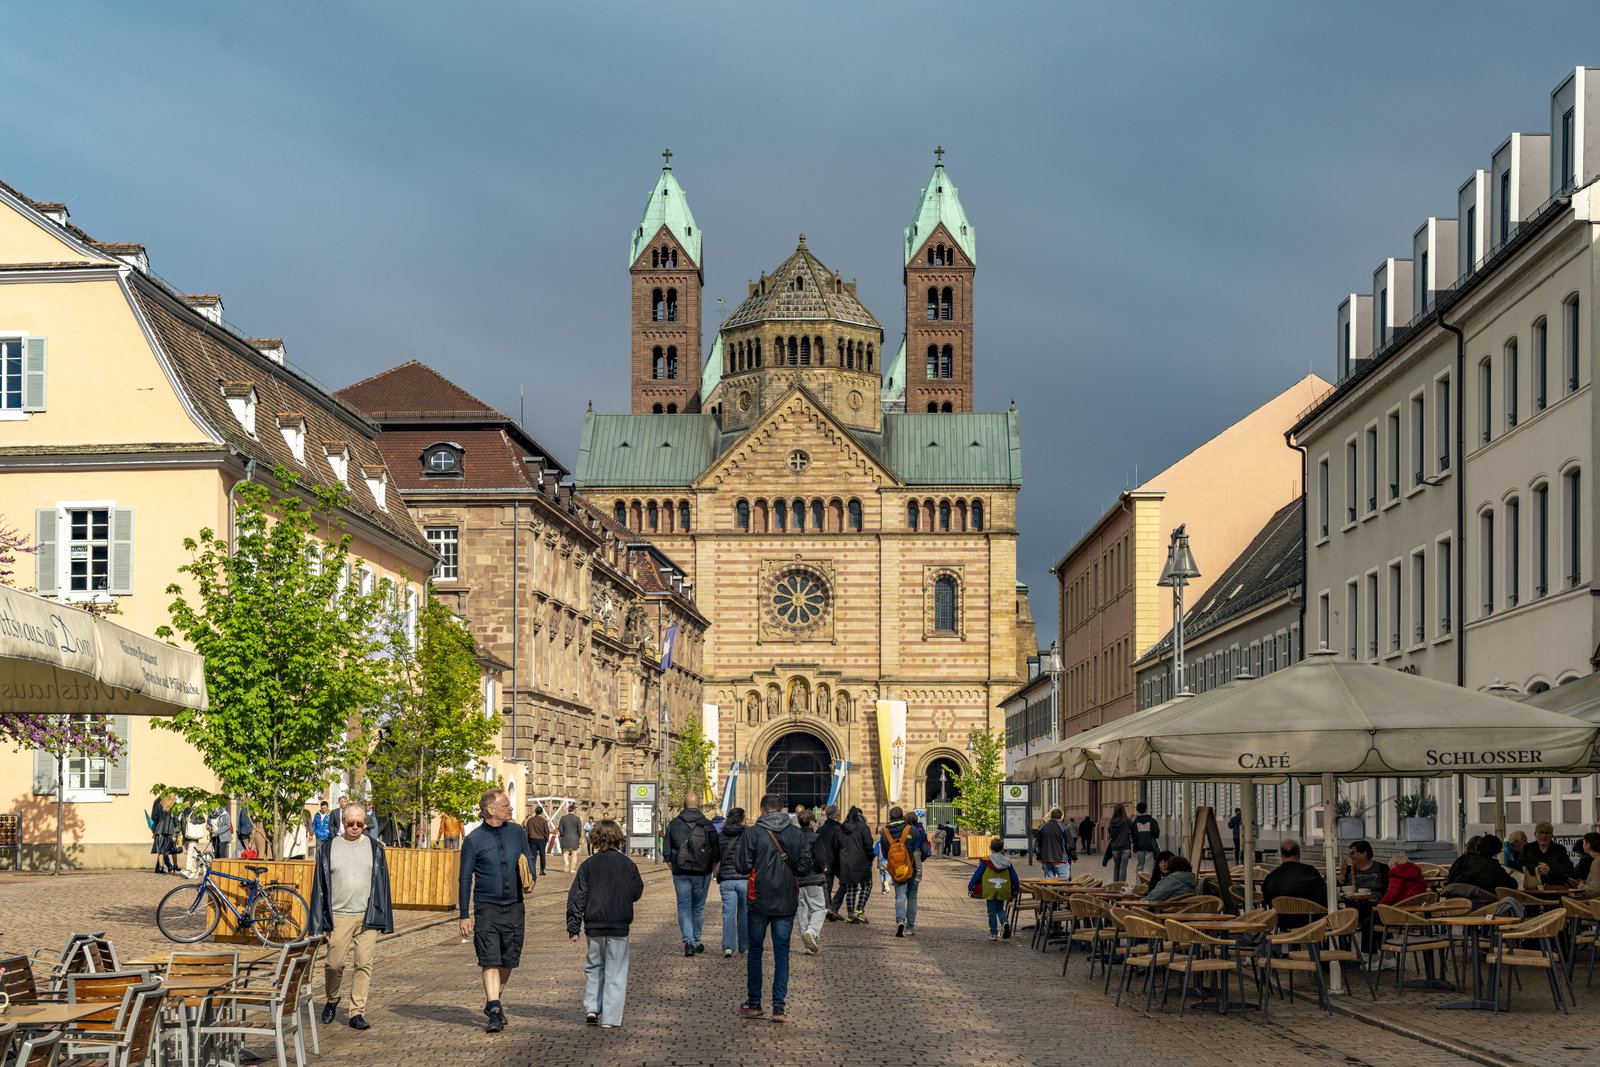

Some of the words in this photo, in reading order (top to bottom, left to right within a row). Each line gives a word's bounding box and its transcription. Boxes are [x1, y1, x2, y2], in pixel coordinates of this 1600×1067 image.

[50, 614, 93, 657] Dom
[1237, 751, 1291, 769] CAFÉ
[1426, 749, 1543, 766] SCHLOSSER
